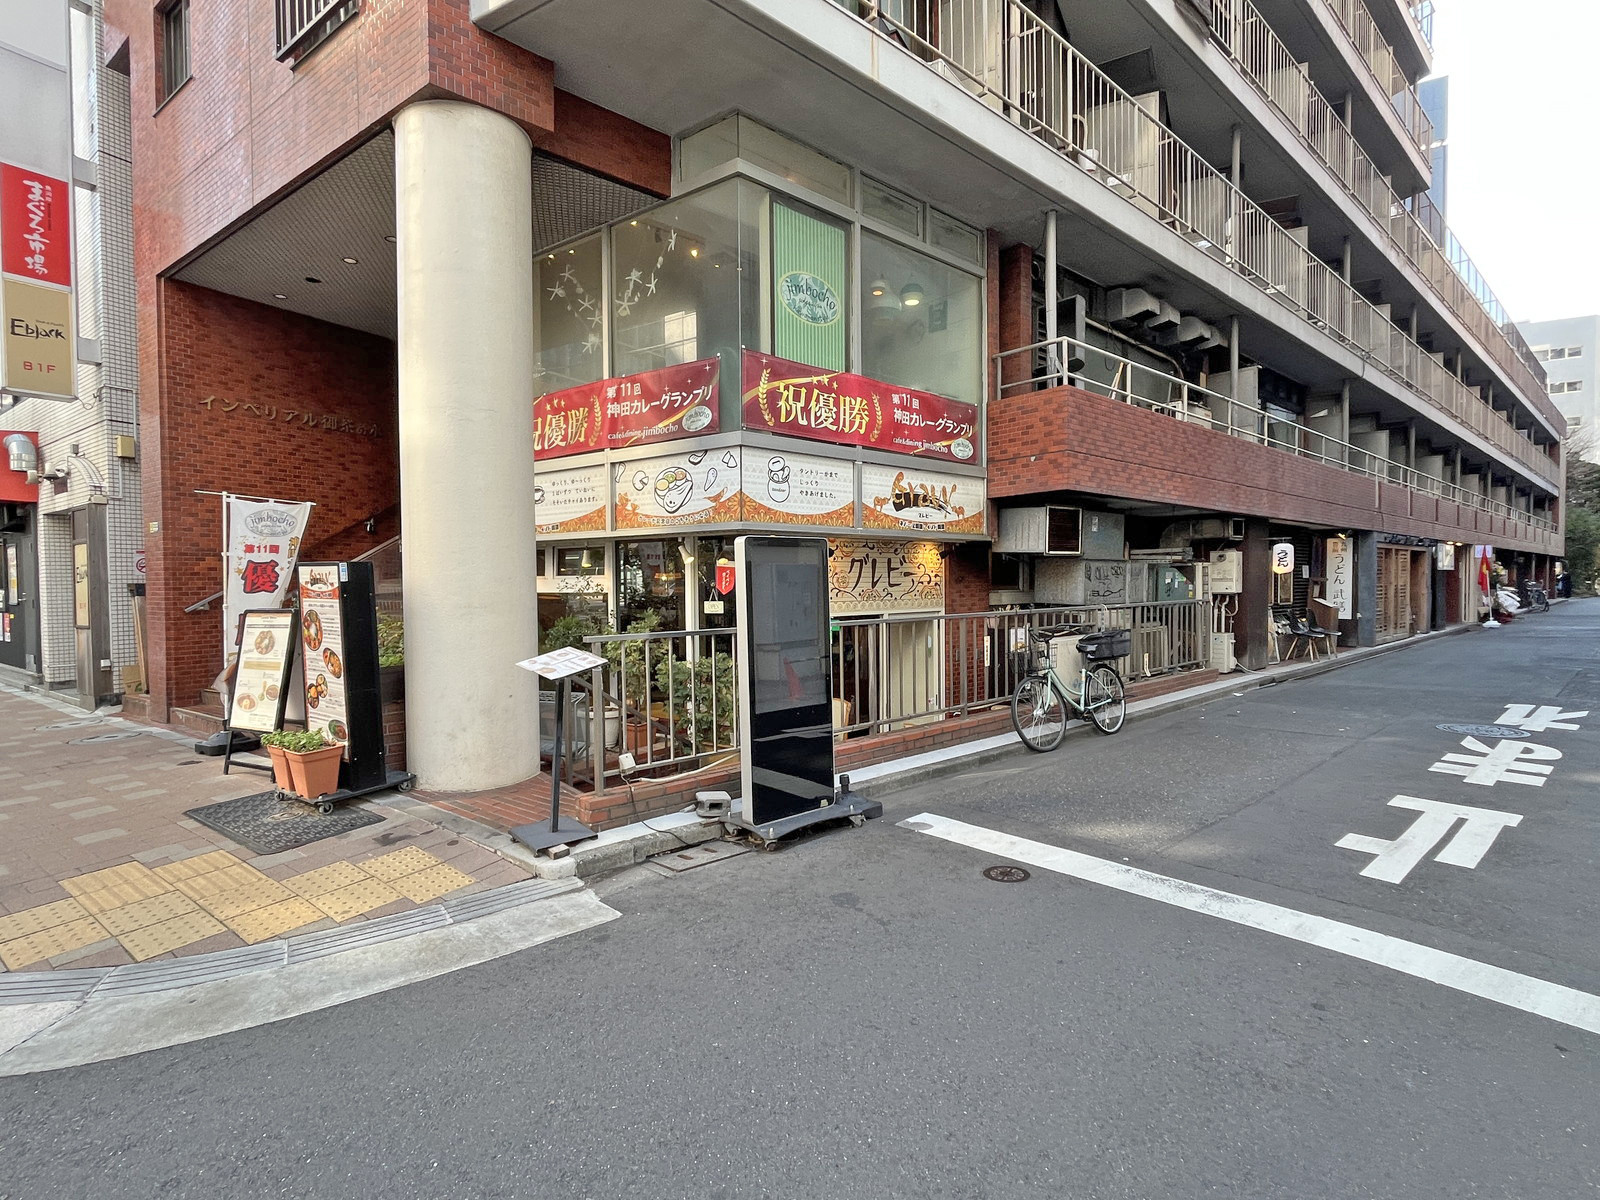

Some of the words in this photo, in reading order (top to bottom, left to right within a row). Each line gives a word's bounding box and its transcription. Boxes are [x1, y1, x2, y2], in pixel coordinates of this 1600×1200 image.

[786, 278, 836, 310] jimbocho
[23, 361, 56, 374] B1F
[606, 382, 642, 399] 第11回
[606, 385, 713, 419] 神田カレーグランプリ
[891, 393, 920, 410] 第11回
[776, 382, 871, 435] 祝優勝
[641, 422, 679, 439] jimbocho
[893, 407, 973, 437] 神田カレーグランプリ
[250, 512, 295, 527] jimbocho
[243, 544, 280, 554] 第11回
[1277, 549, 1289, 568] うどん
[847, 553, 918, 593] グレビー
[1333, 553, 1346, 585] うどん
[1334, 703, 1590, 884] 止まれ
